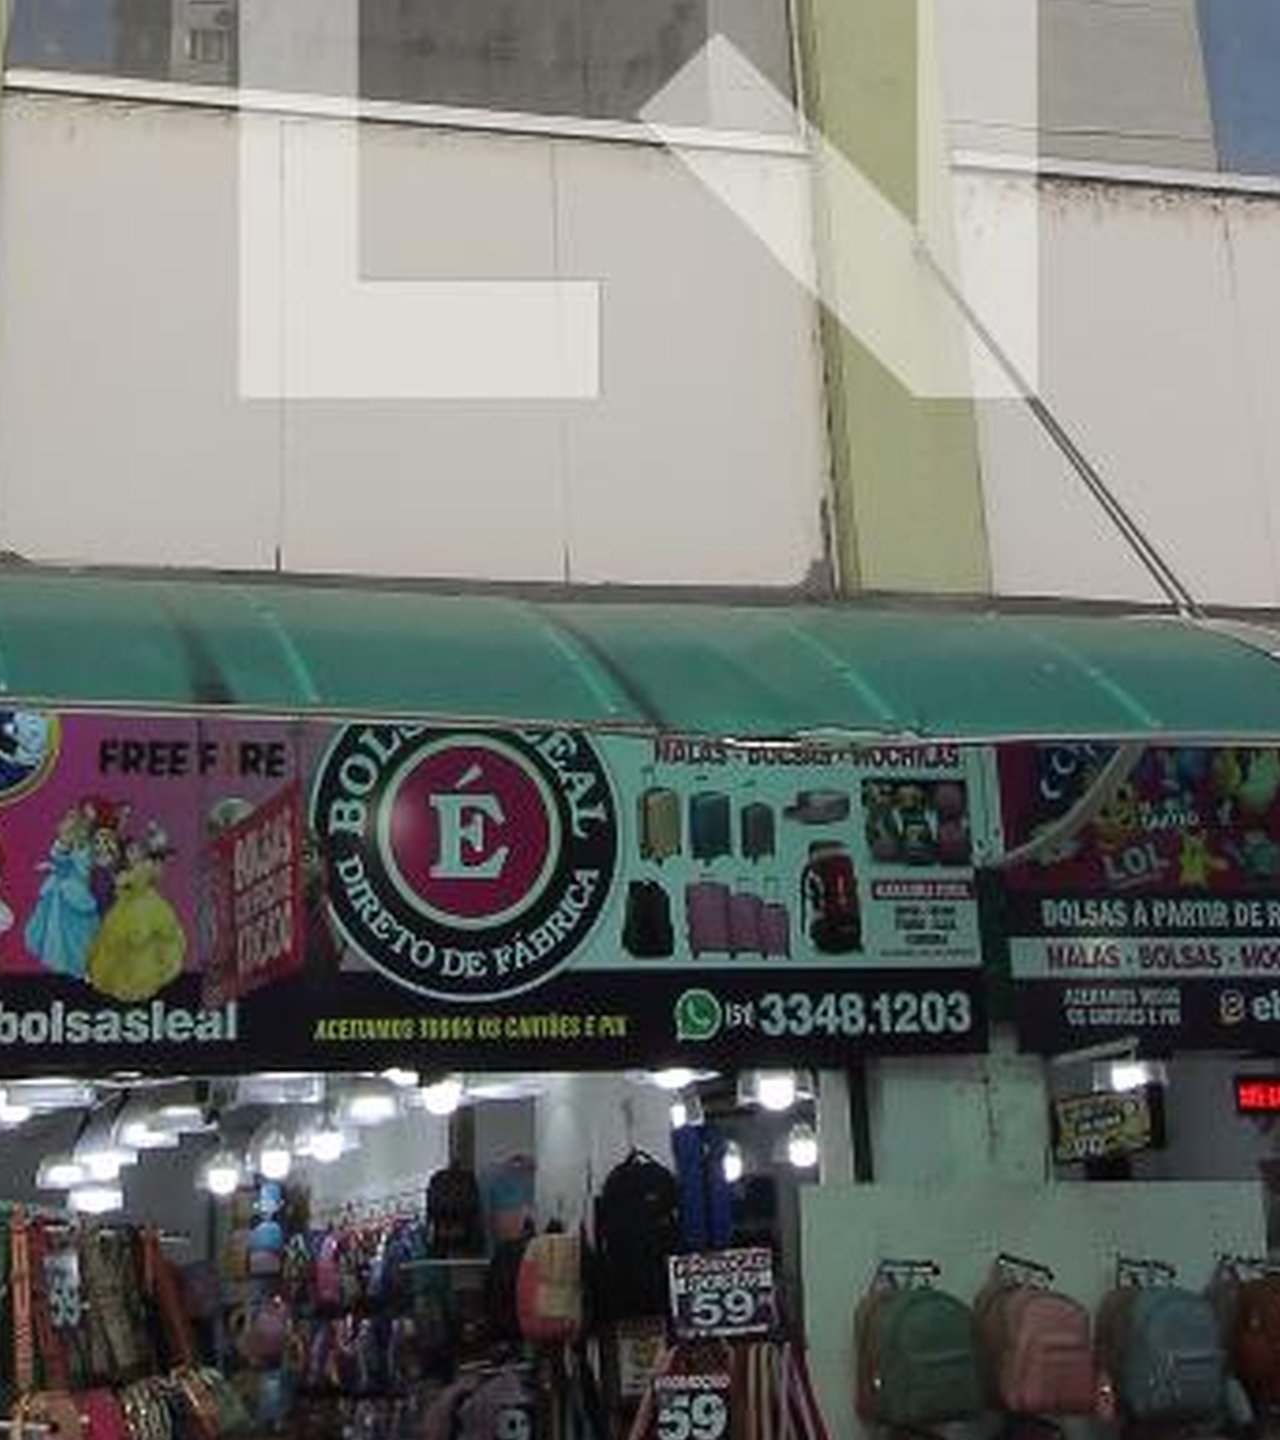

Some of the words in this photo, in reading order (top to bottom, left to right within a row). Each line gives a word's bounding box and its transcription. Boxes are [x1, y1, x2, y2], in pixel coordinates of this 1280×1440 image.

[99, 742, 190, 778] FREE
[429, 763, 509, 879] É
[1103, 841, 1170, 880] LOL
[336, 853, 436, 969] DIRETO
[440, 948, 488, 977] DE
[496, 868, 600, 977] FÁBRICA
[1041, 899, 1129, 928] BOLSAS
[1133, 899, 1149, 927] A
[1151, 899, 1230, 928] PARTIR
[1234, 901, 1264, 928] DE
[1046, 944, 1121, 967] MALAS
[1138, 944, 1222, 967] BOLSAS
[758, 991, 971, 1035] 3348.1203
[691, 1290, 756, 1326] 59
